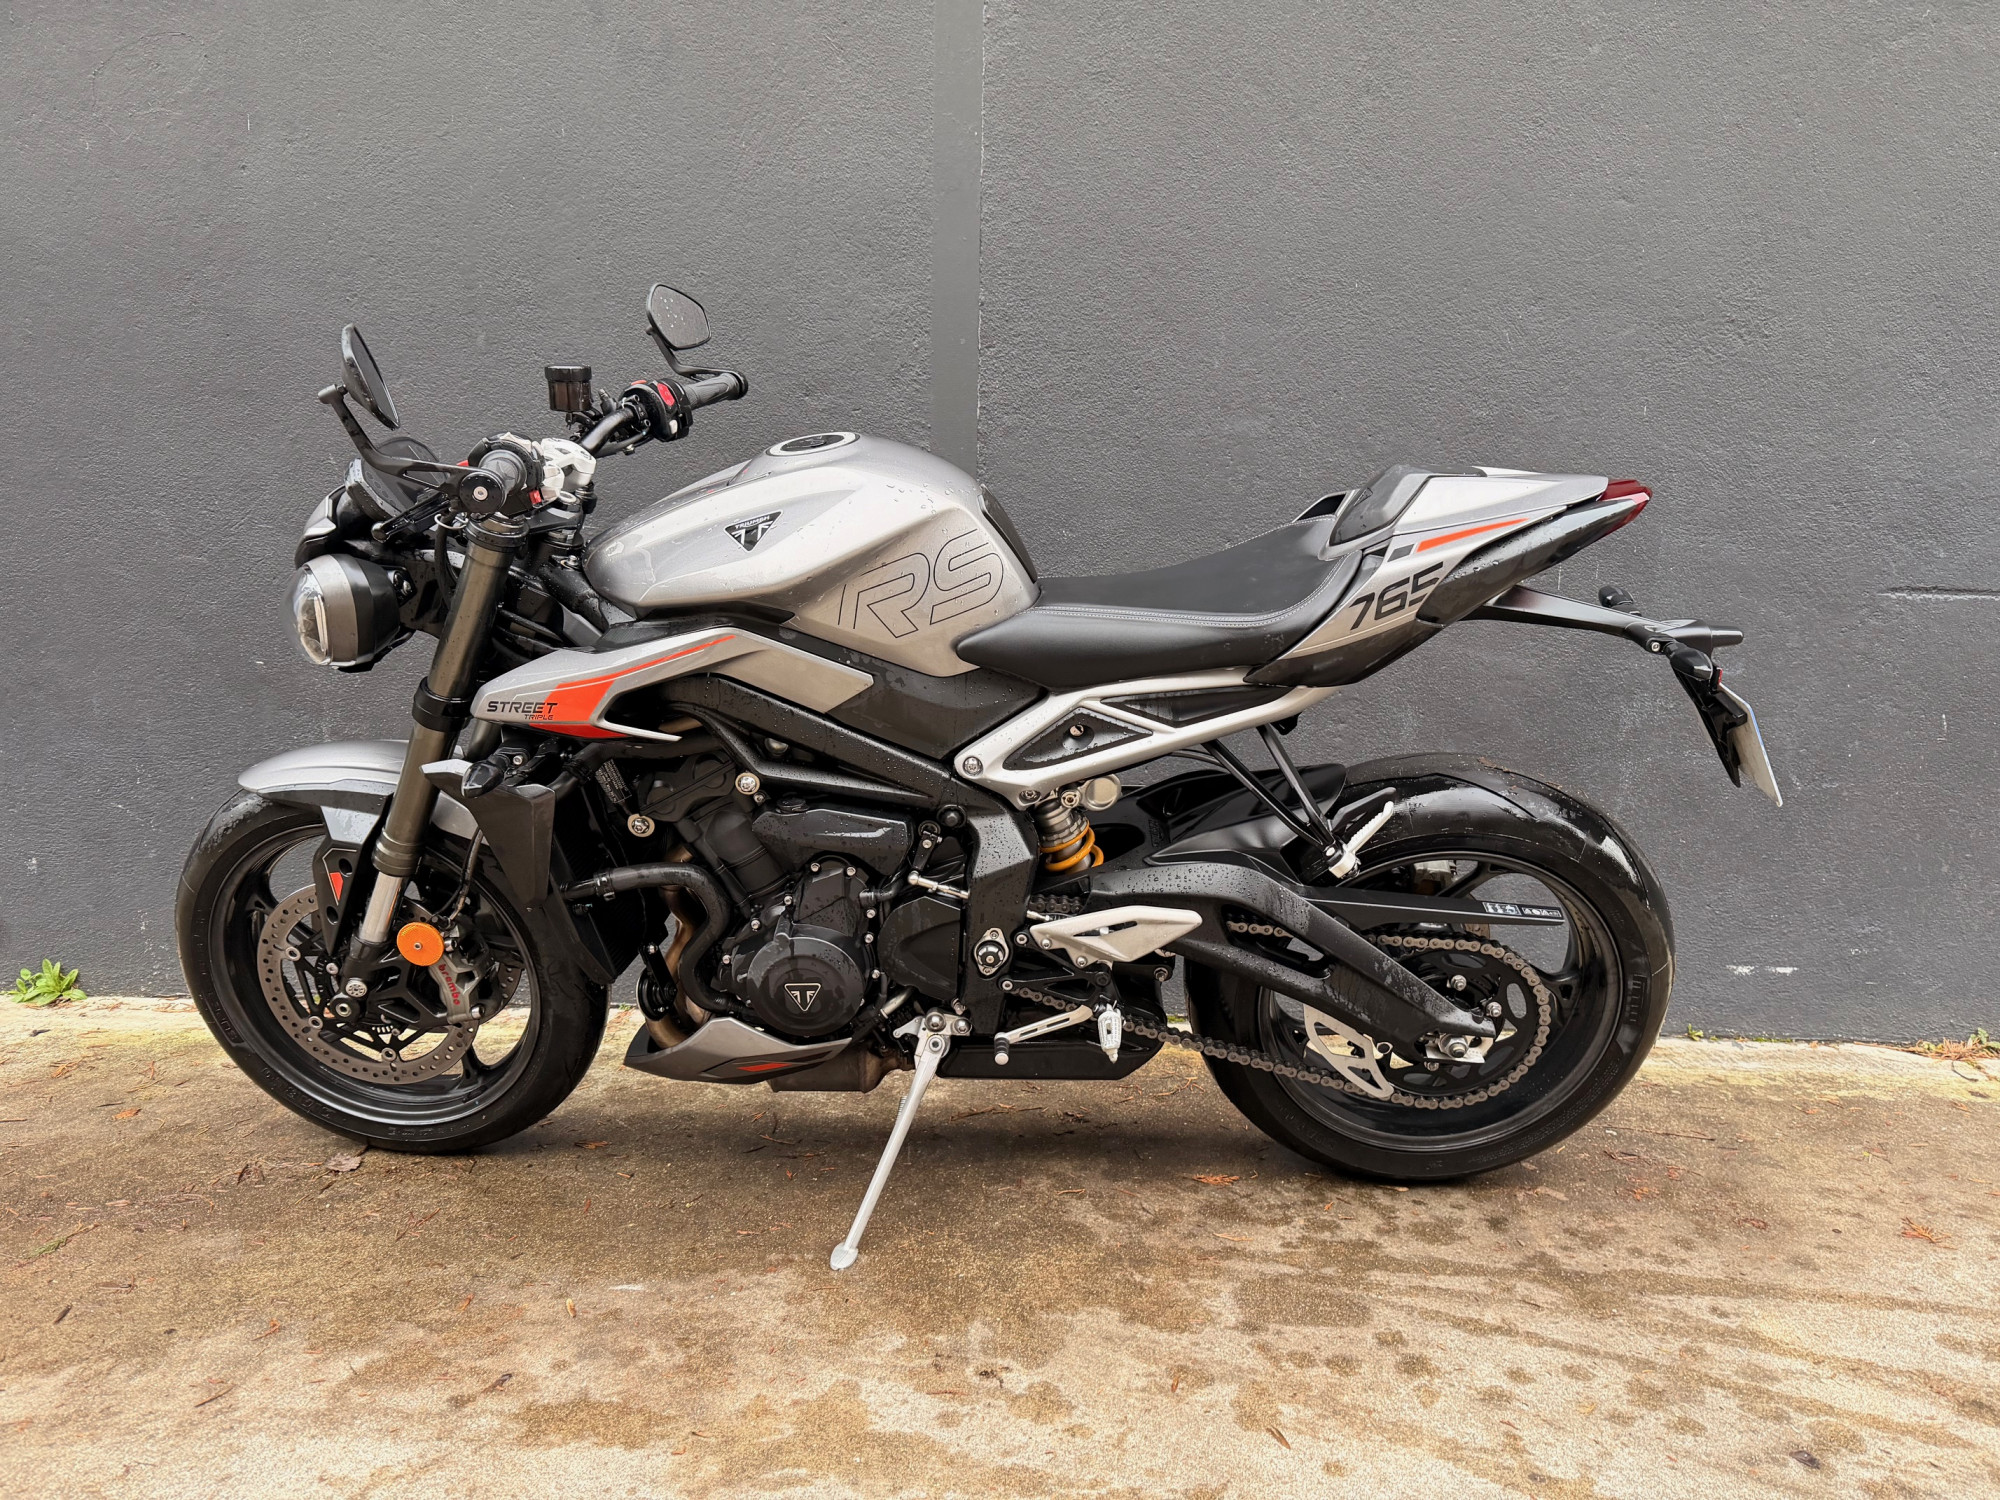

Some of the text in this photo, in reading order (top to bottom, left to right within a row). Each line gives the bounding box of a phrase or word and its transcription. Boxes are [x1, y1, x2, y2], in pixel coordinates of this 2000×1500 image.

[735, 515, 770, 529] TRIUMPH
[838, 528, 1004, 639] RS
[1348, 561, 1444, 631] 765
[488, 700, 558, 714] STREET
[438, 963, 461, 1006] brembo
